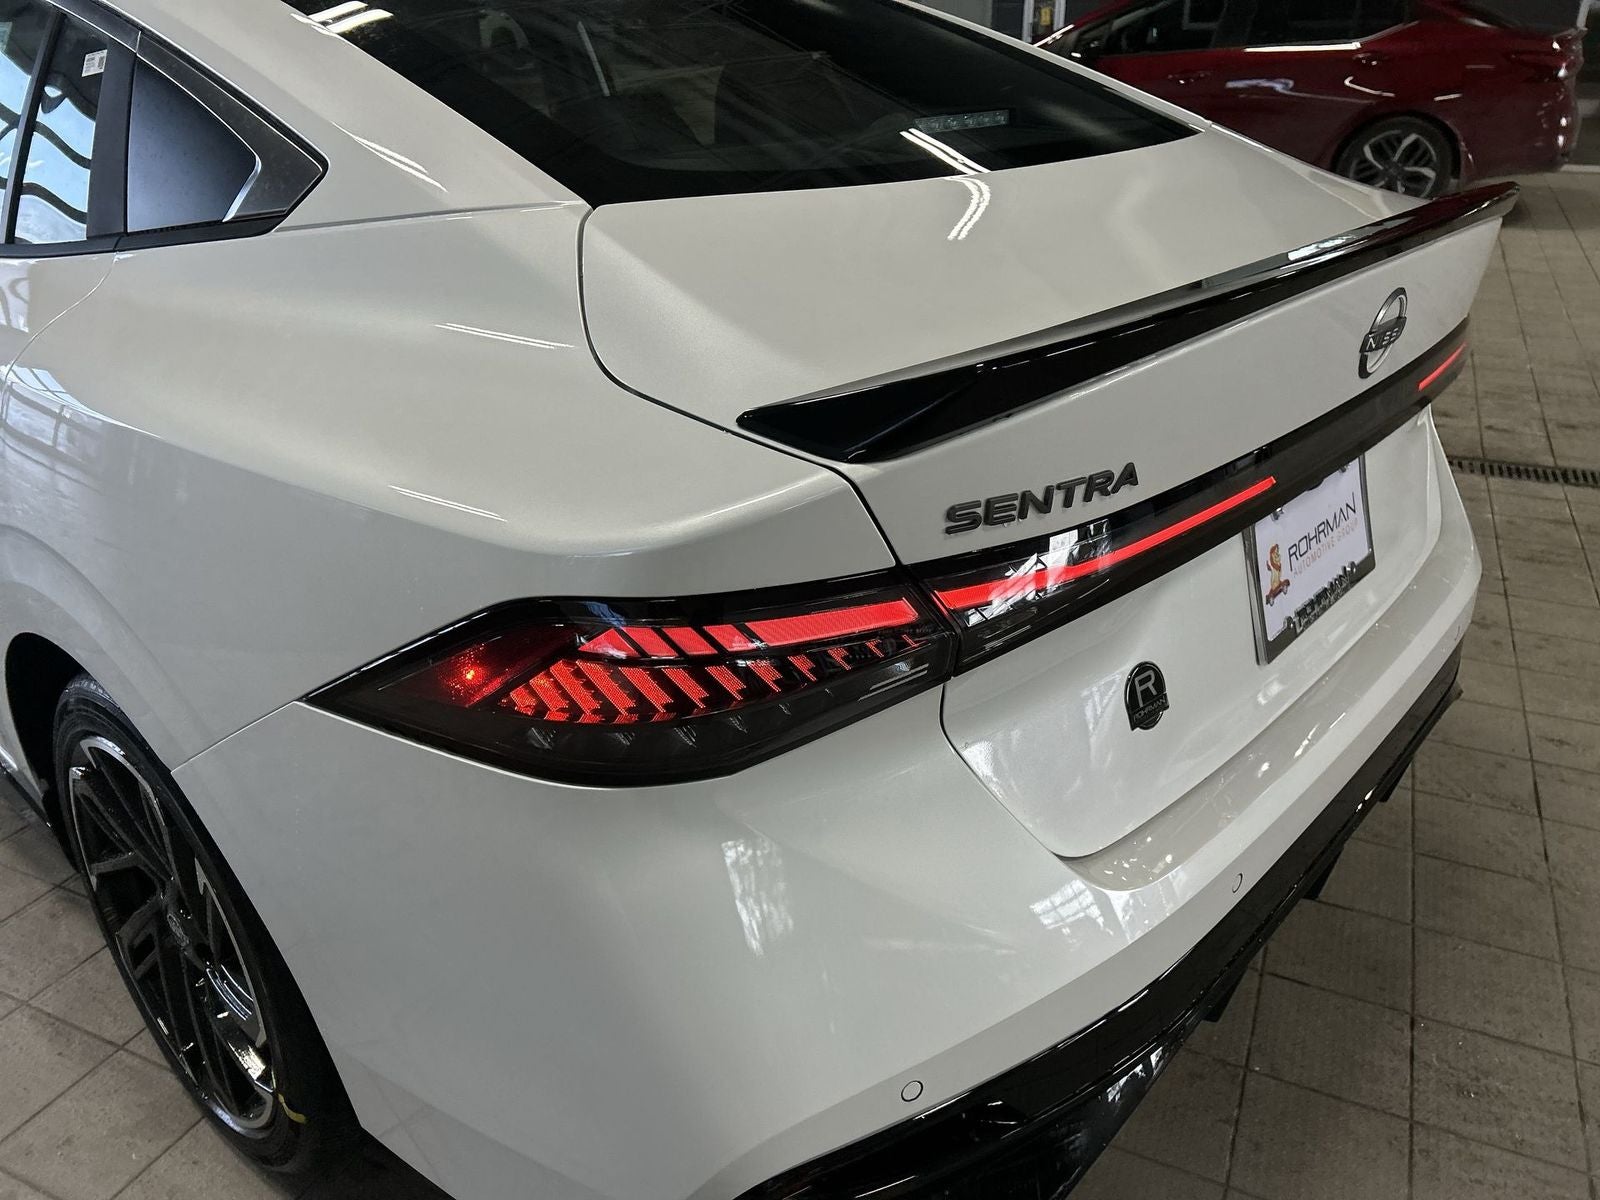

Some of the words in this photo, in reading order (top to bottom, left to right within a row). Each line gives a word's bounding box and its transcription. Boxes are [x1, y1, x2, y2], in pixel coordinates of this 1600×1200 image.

[945, 462, 1139, 535] SENTRA
[1288, 492, 1356, 572] ROHRMAN
[1293, 535, 1335, 576] AUTOMOTIVE
[1134, 669, 1158, 708] R
